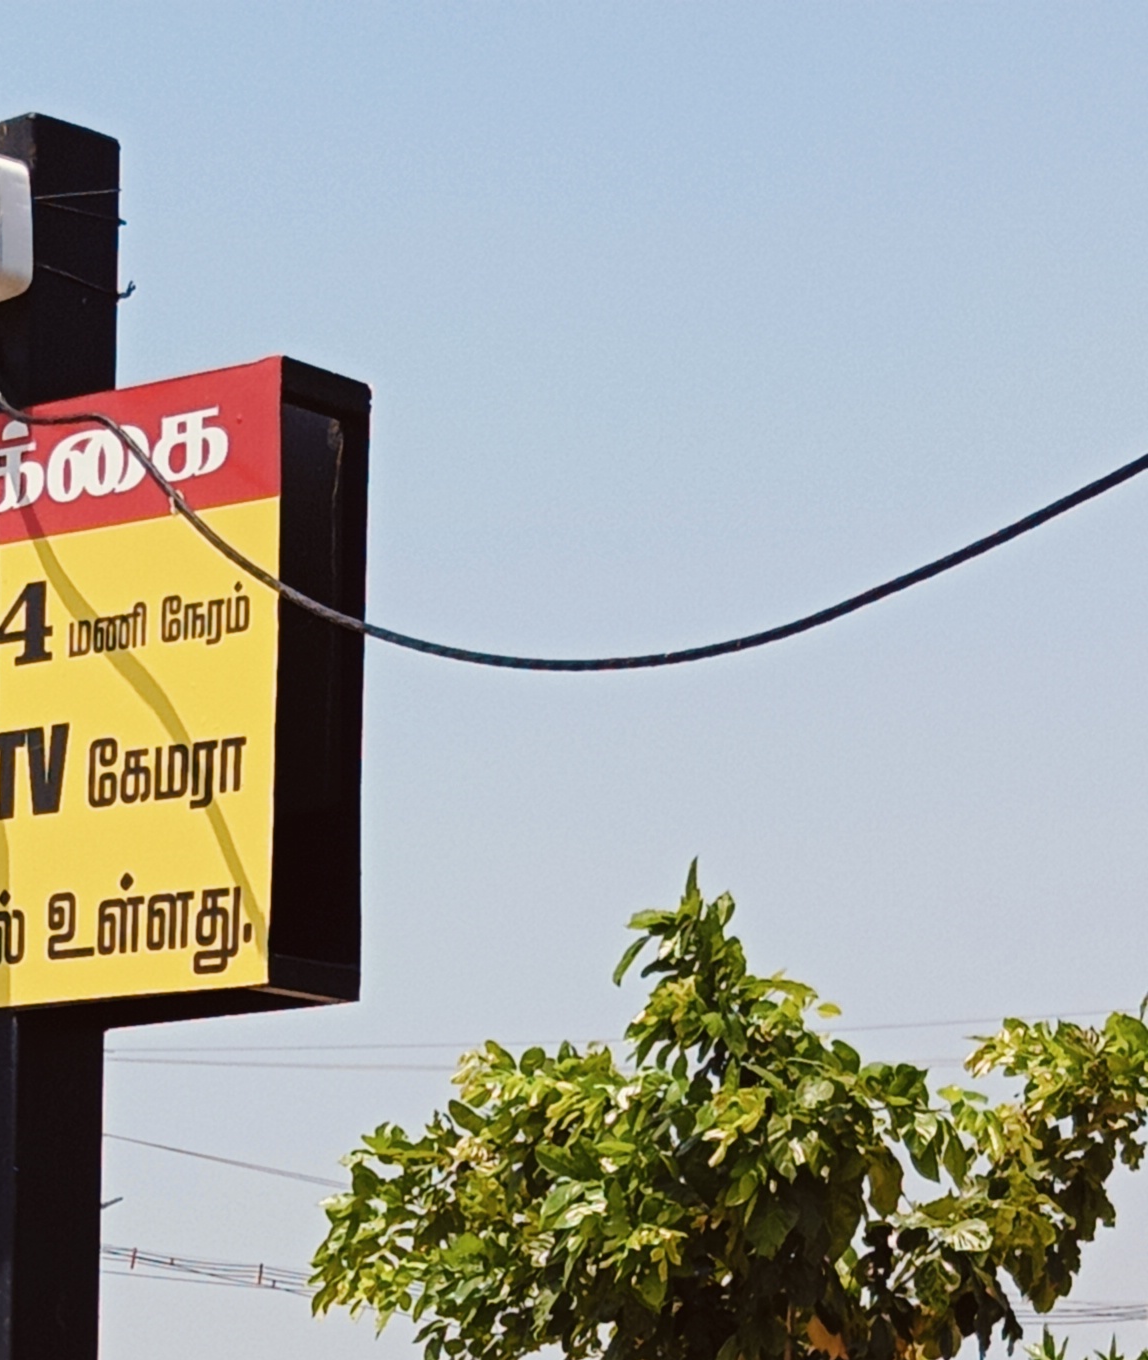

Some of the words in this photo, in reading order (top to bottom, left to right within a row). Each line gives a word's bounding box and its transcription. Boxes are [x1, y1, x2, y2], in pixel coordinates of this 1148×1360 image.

[67, 601, 147, 658] மணி
[160, 580, 251, 646] நேரம்
[87, 737, 248, 810] கேமரா
[47, 872, 253, 975] உள்ளது.
